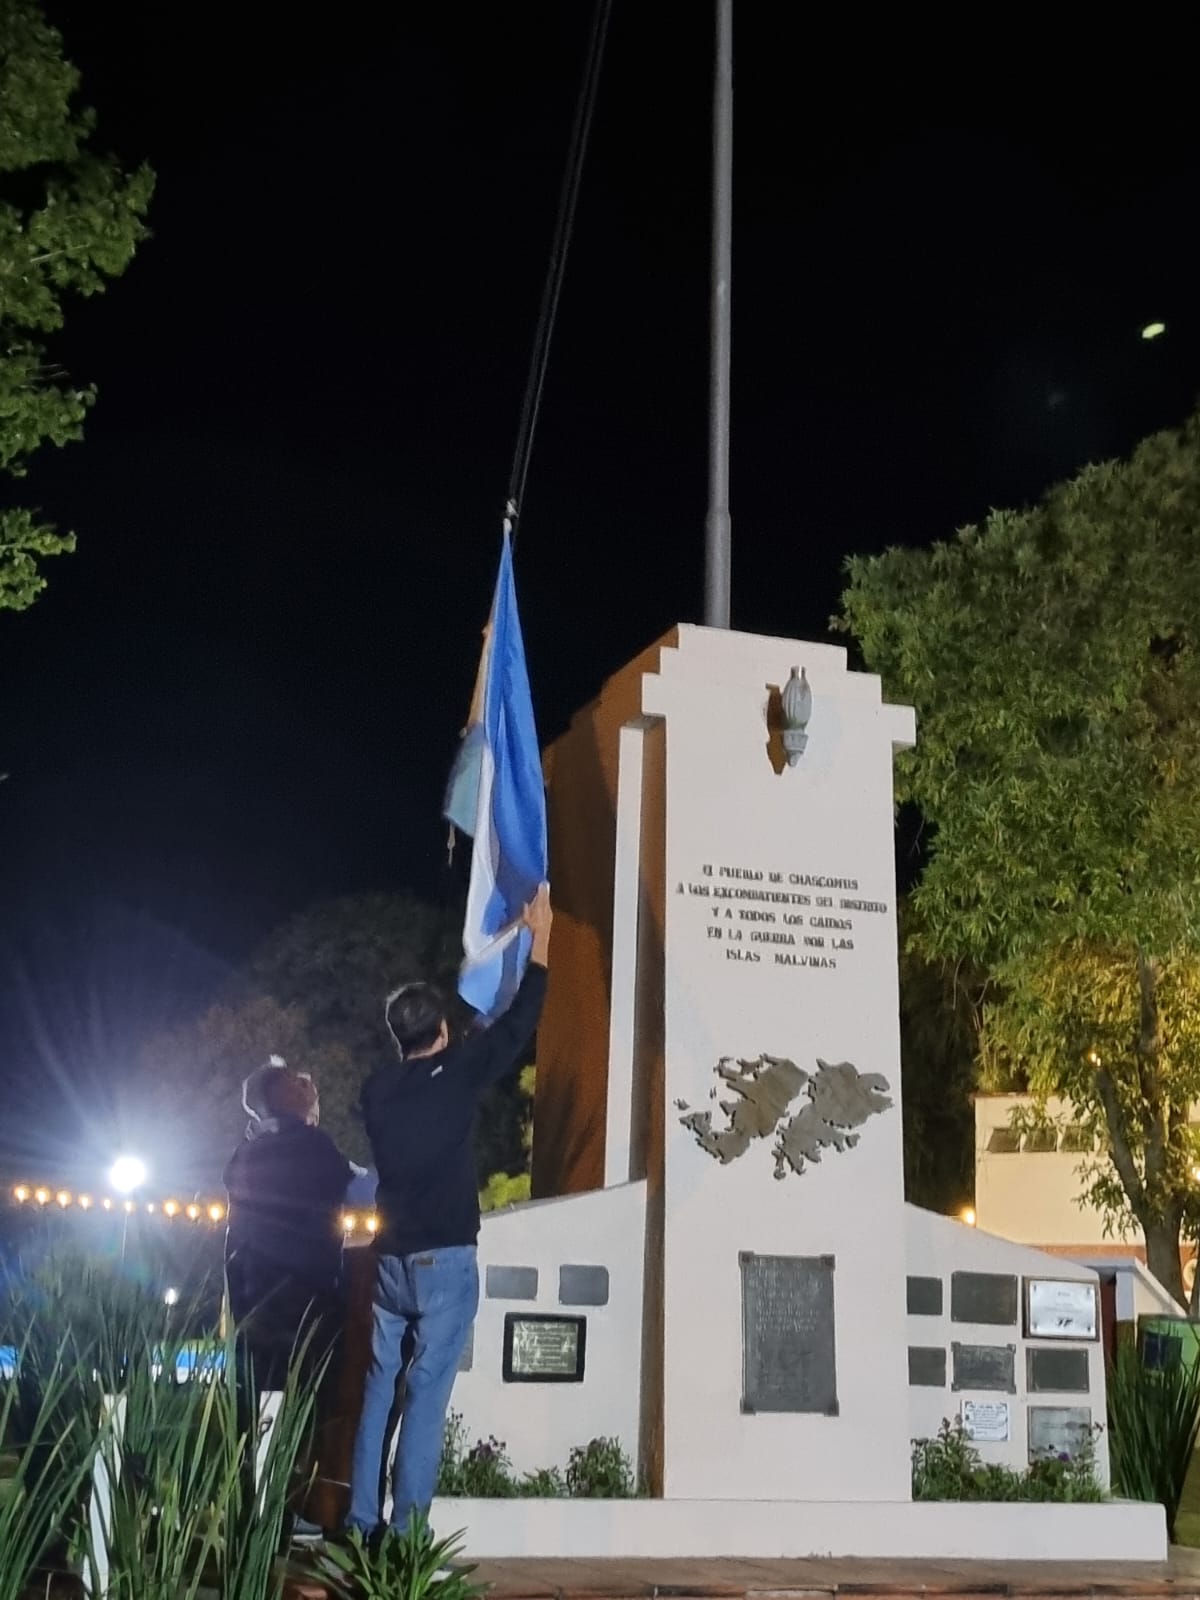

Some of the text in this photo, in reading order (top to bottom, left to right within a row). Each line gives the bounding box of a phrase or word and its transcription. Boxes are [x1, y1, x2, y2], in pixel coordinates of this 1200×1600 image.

[719, 866, 763, 881] PUEBLO
[789, 873, 859, 890] CHASCOMUS
[676, 882, 685, 895] A
[689, 883, 710, 896] LOS
[713, 887, 811, 906] EXCOMBATIENTES
[711, 907, 853, 931] Y A TODOS LOS CAIDOS
[706, 926, 854, 951] EN LA GUERRA POR LAS
[726, 948, 837, 969] ISLAS MALVINAS
